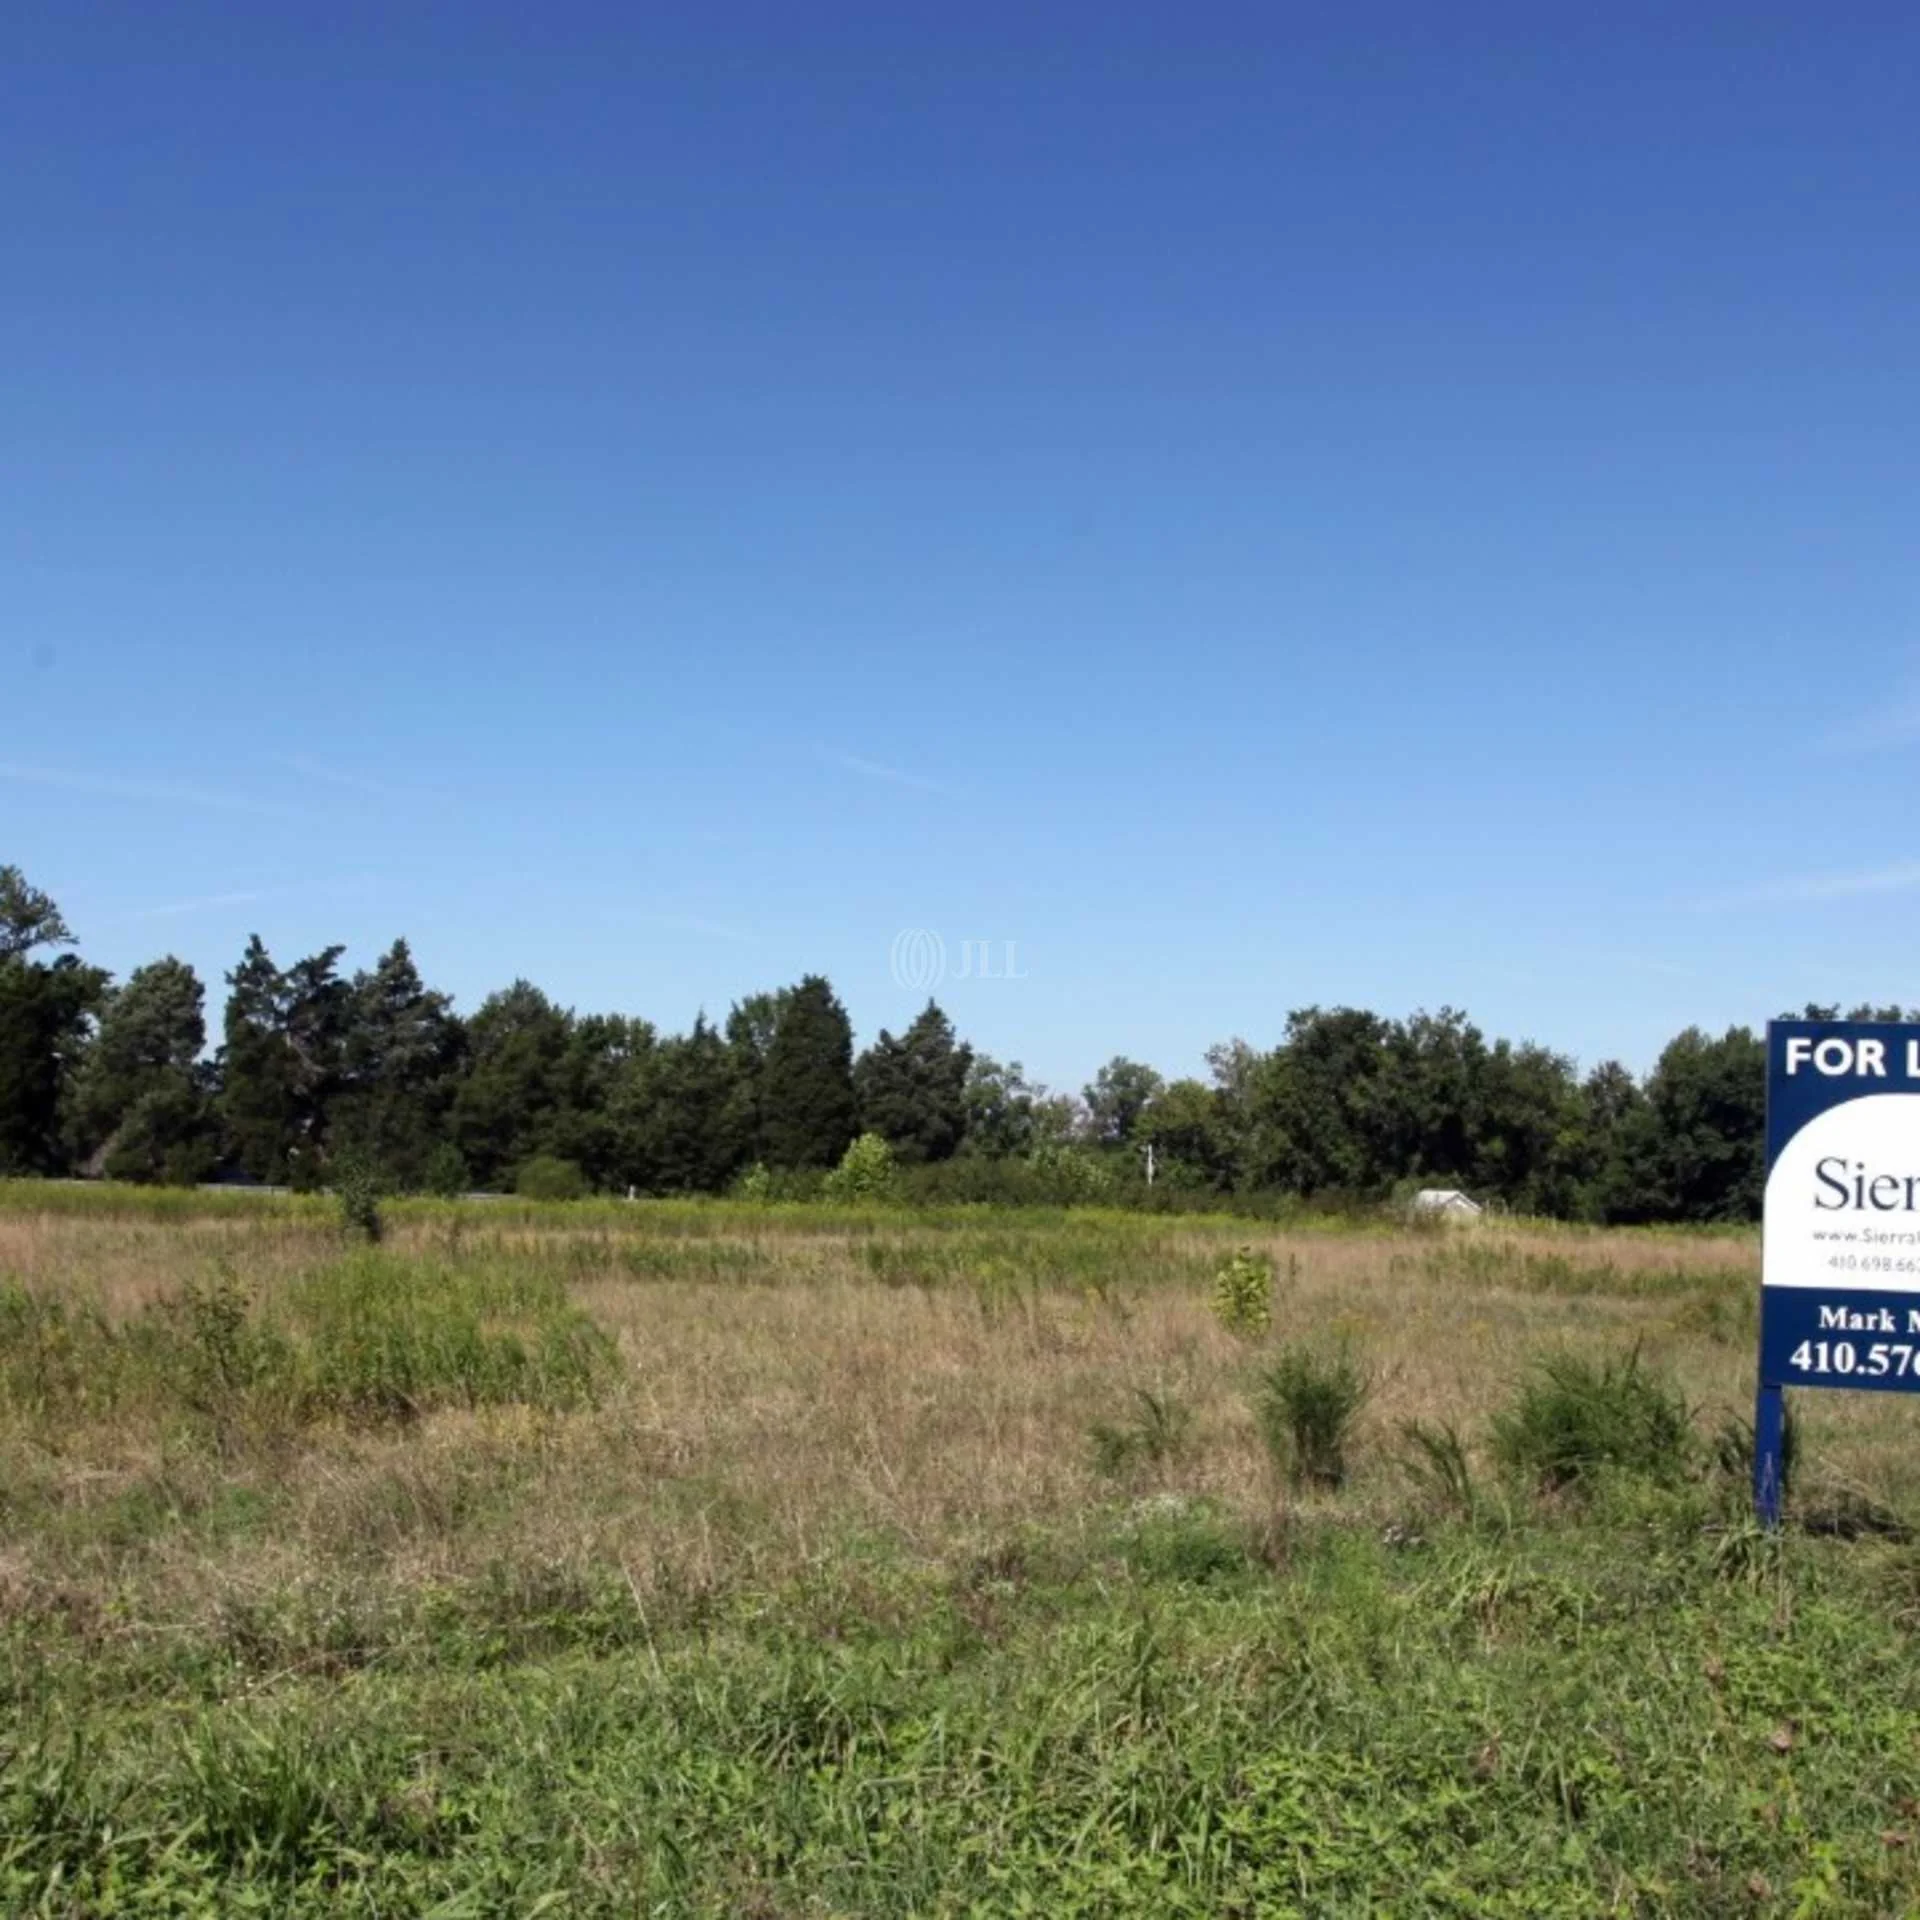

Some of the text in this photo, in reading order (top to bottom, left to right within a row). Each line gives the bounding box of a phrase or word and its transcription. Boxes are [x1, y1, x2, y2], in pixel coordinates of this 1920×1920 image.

[1786, 1037, 1887, 1077] FOR
[1813, 1226, 1920, 1245] www.Sierra
[1827, 1254, 1920, 1273] 410.698.66
[1818, 1304, 1896, 1333] Mark
